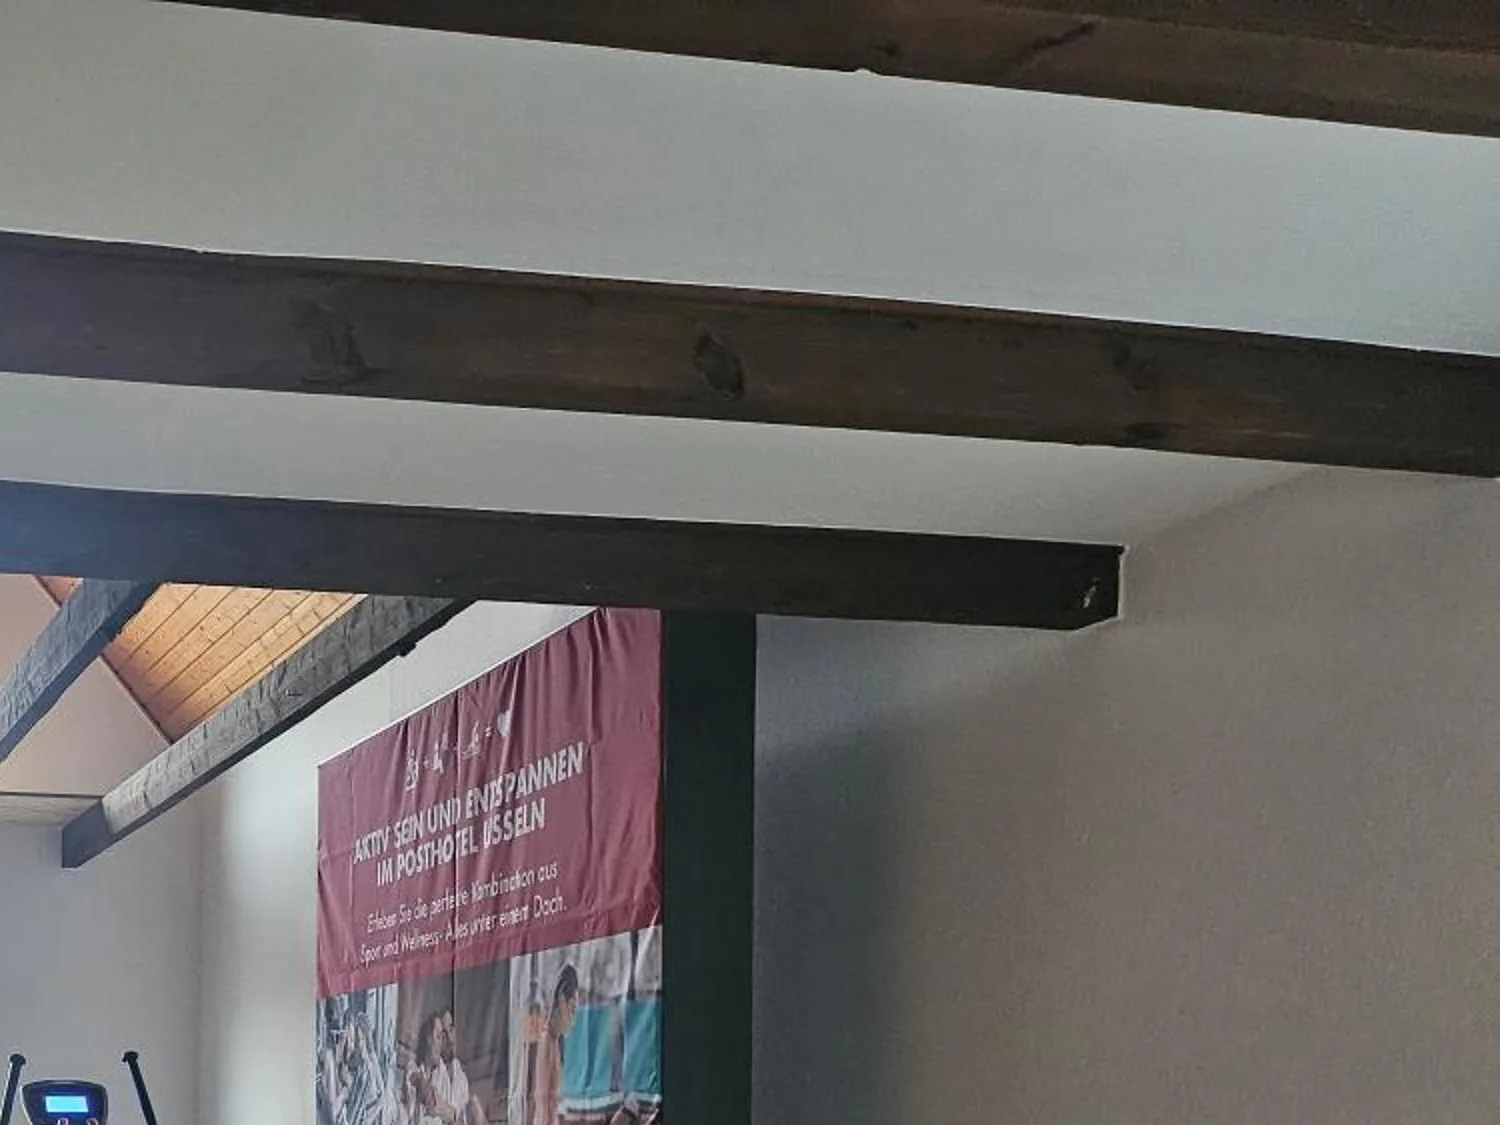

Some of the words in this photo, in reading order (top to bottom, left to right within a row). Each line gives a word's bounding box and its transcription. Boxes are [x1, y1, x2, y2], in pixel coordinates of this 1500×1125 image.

[353, 826, 390, 864] AKTIV
[394, 812, 423, 849] SEIN
[427, 798, 460, 833] UND
[466, 741, 583, 819] ENTSPANNEN
[377, 857, 393, 887] IM
[397, 825, 479, 880] POSTHOTEL
[429, 887, 469, 922] perfete
[538, 862, 558, 882] aus
[445, 920, 468, 941] Ales
